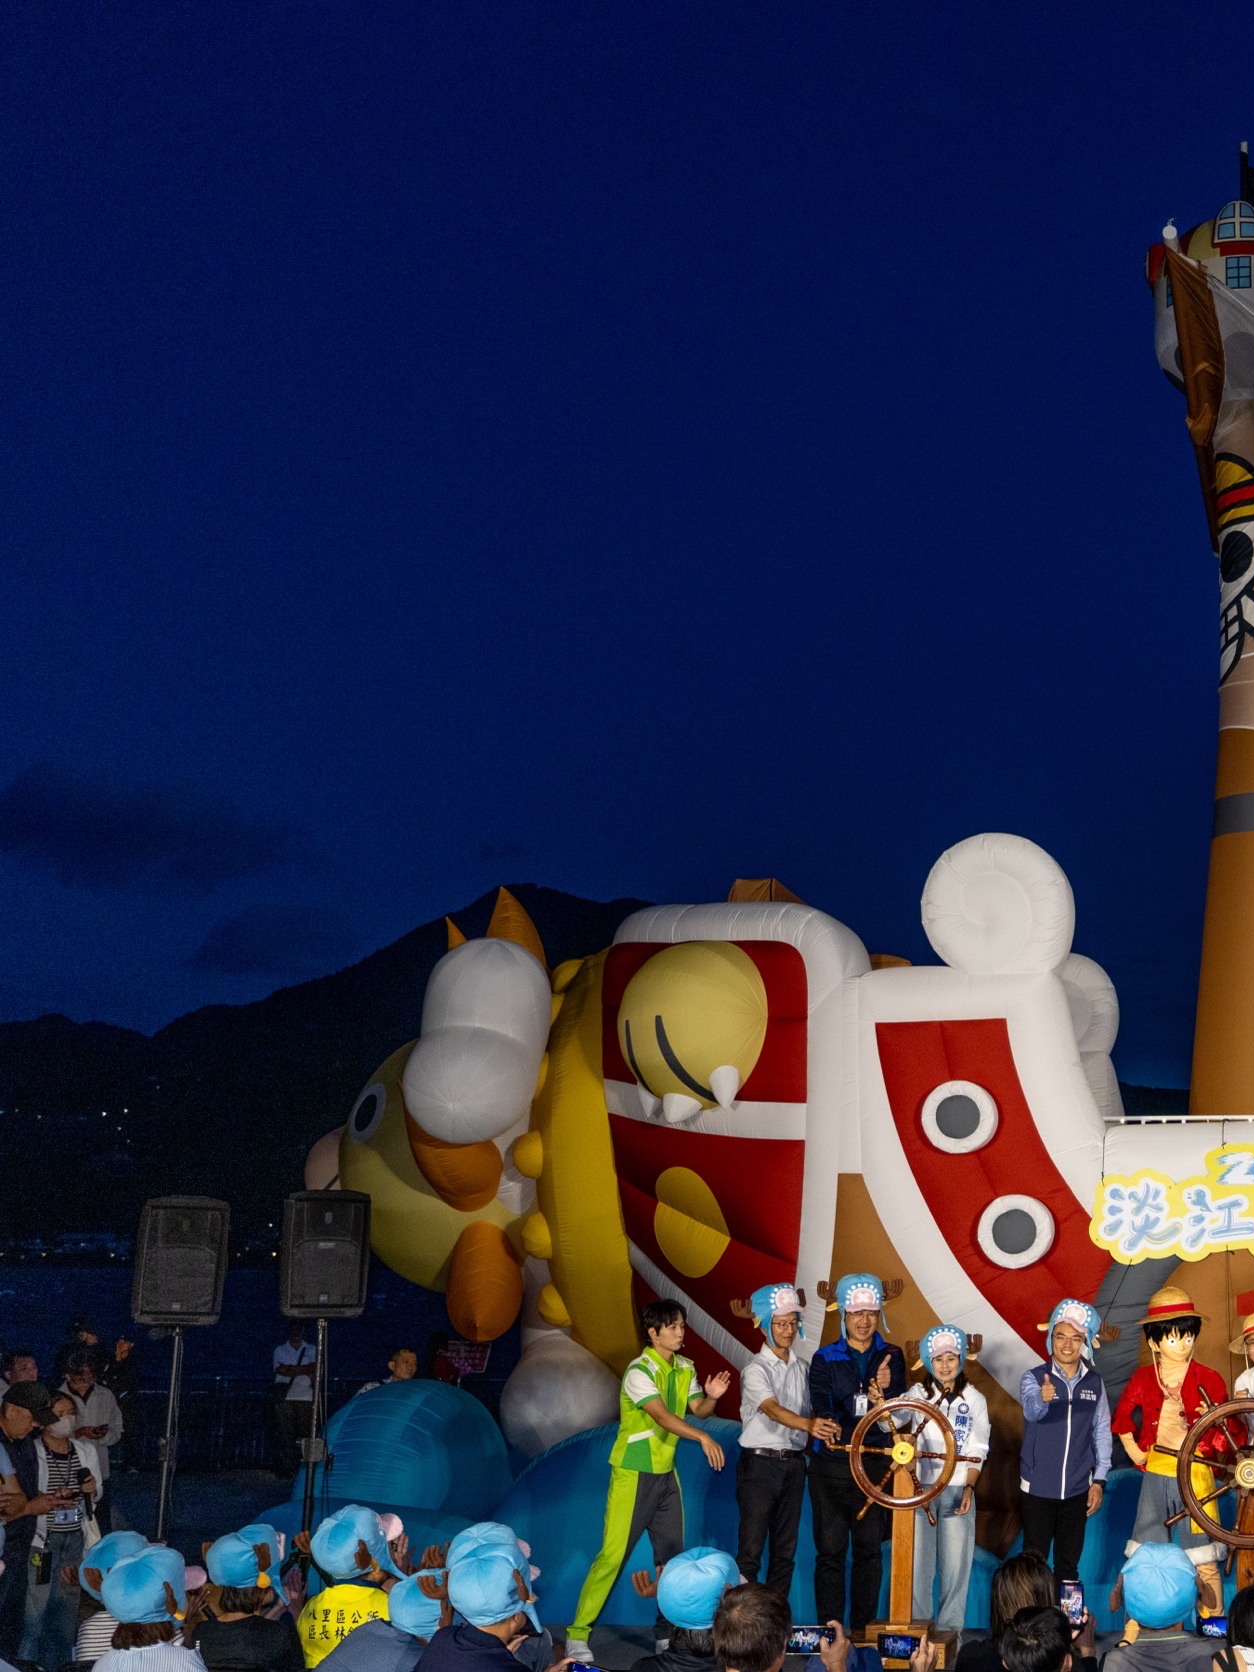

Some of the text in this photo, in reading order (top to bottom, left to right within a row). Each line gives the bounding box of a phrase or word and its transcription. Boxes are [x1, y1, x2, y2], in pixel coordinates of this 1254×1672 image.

[307, 1608, 379, 1624] 八里區公所
